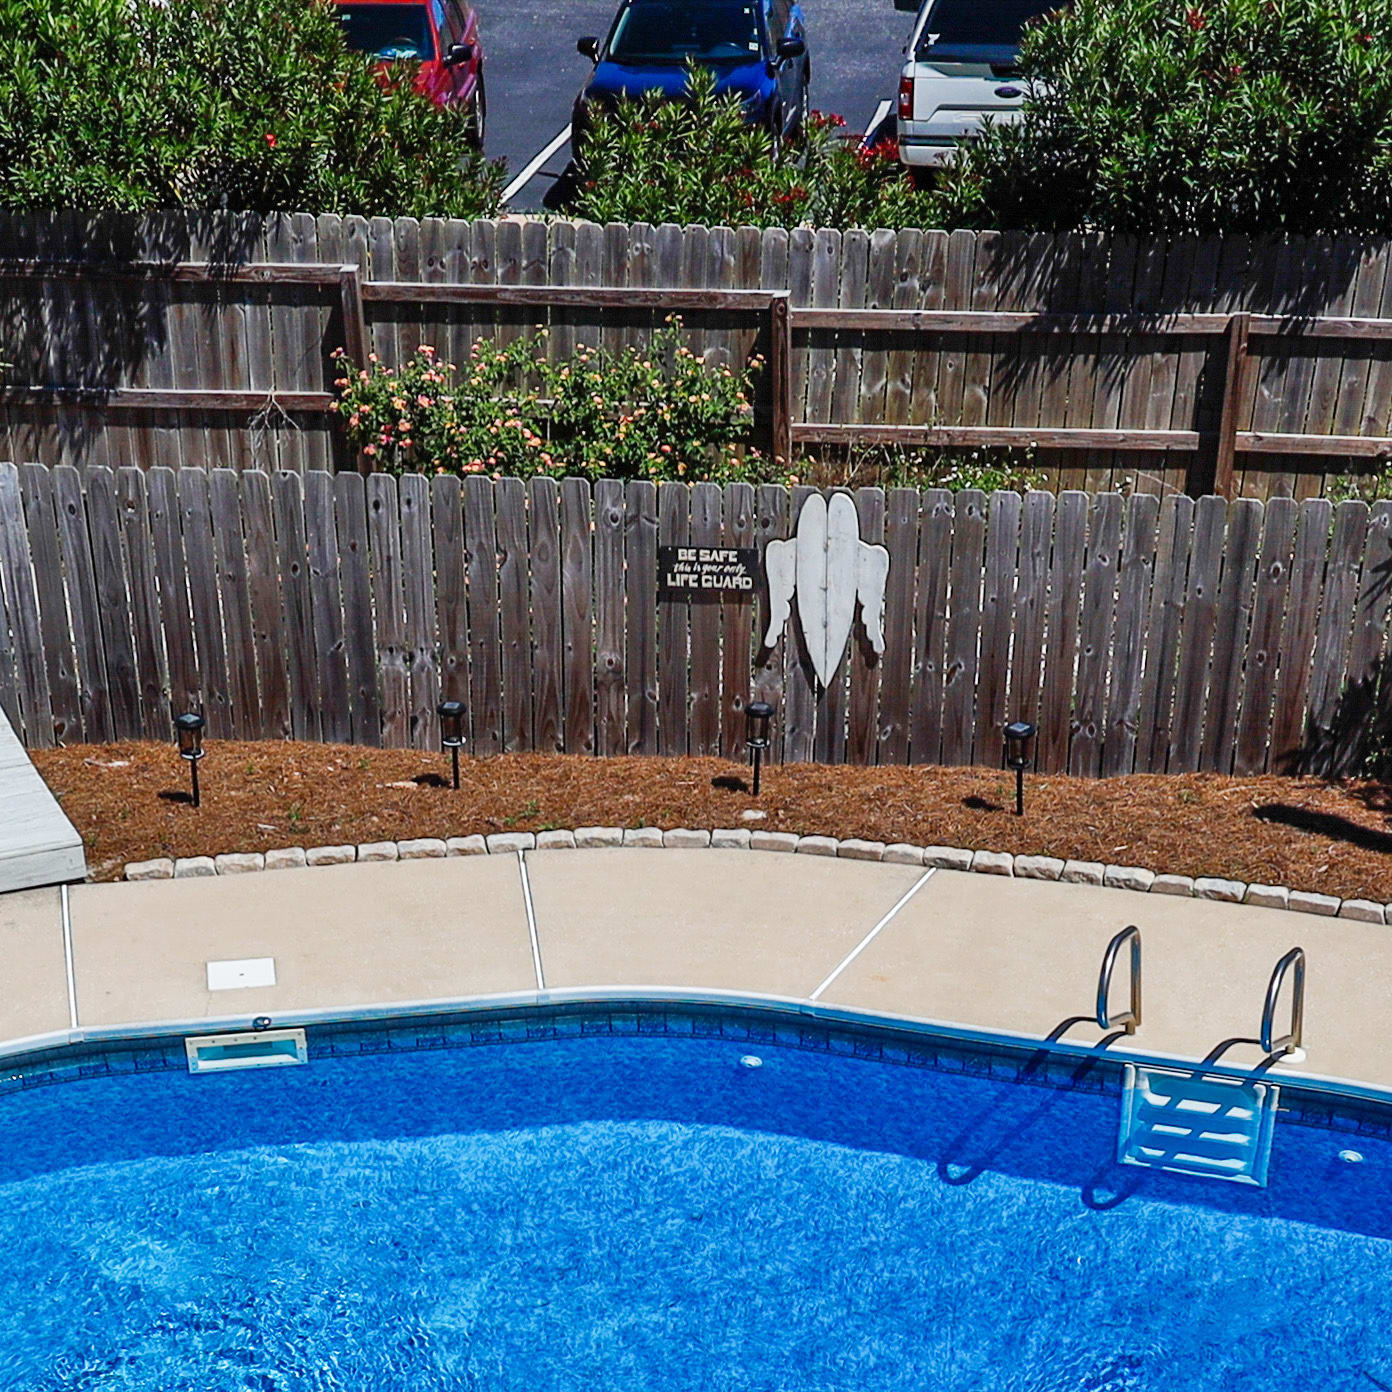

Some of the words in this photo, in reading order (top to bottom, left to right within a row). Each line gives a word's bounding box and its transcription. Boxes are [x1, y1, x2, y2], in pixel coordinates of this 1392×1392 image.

[678, 549, 696, 561] BE
[699, 549, 737, 562] SAFE
[673, 562, 690, 572] this
[693, 562, 701, 571] is
[702, 564, 723, 575] your
[724, 563, 746, 577] only
[667, 573, 698, 588] LIFE
[702, 575, 752, 589] GUARD
